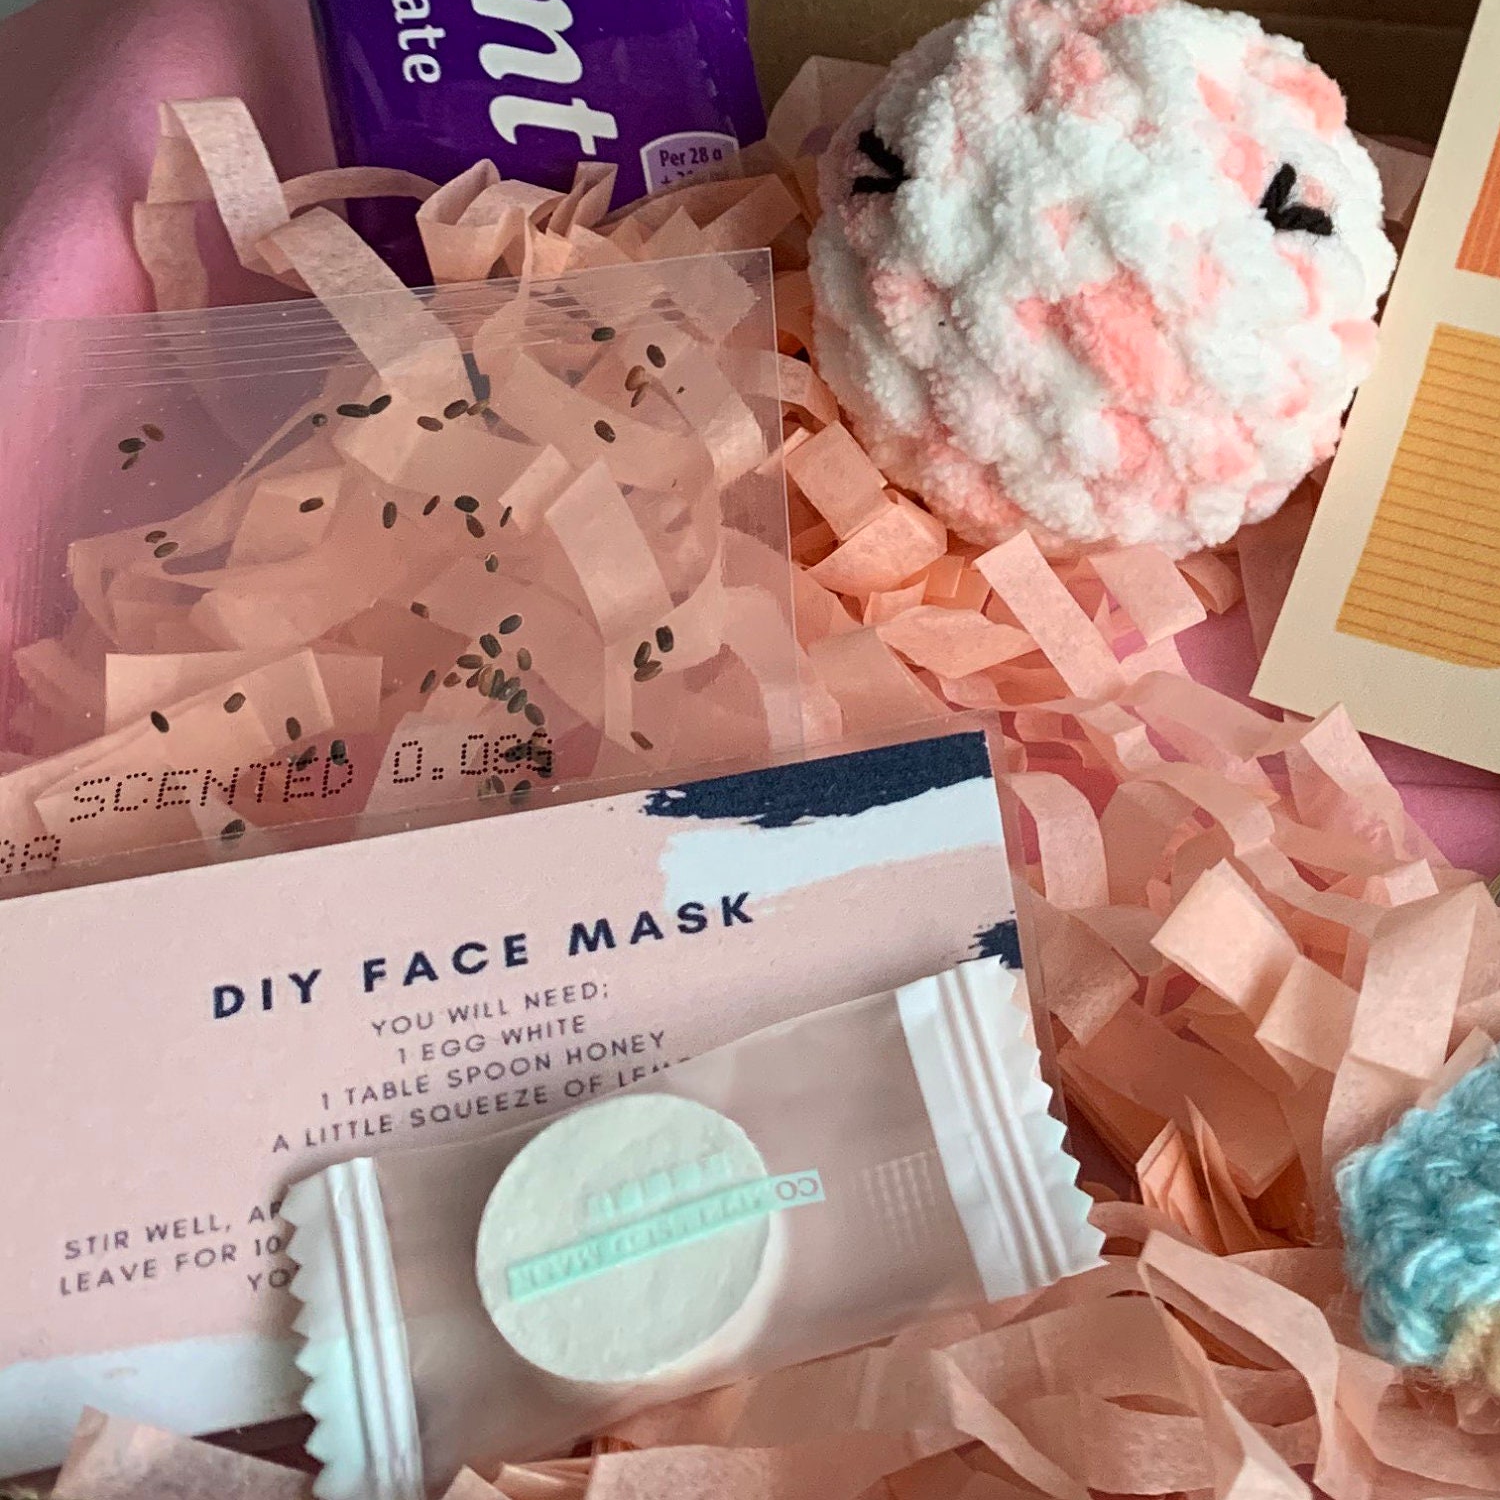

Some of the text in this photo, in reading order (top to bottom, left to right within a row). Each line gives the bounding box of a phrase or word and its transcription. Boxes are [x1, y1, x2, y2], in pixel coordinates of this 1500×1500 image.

[659, 148, 686, 167] Per
[69, 753, 354, 823] SCENTED
[212, 891, 755, 1020] DIY FACE MASK
[370, 1012, 435, 1037] YOU
[447, 998, 510, 1026] WILL
[397, 1014, 586, 1065] 1 EGG WHITE
[320, 1029, 665, 1110] 1 TABLE SPOON HONEY
[271, 1133, 290, 1153] A
[305, 1114, 394, 1147] LITTLE
[409, 1082, 549, 1129] SQUEEZE
[563, 1073, 603, 1098] OF
[60, 1234, 282, 1297] LEAVE FOR 10
[64, 1229, 130, 1261] STIR
[145, 1213, 232, 1244] WELL,
